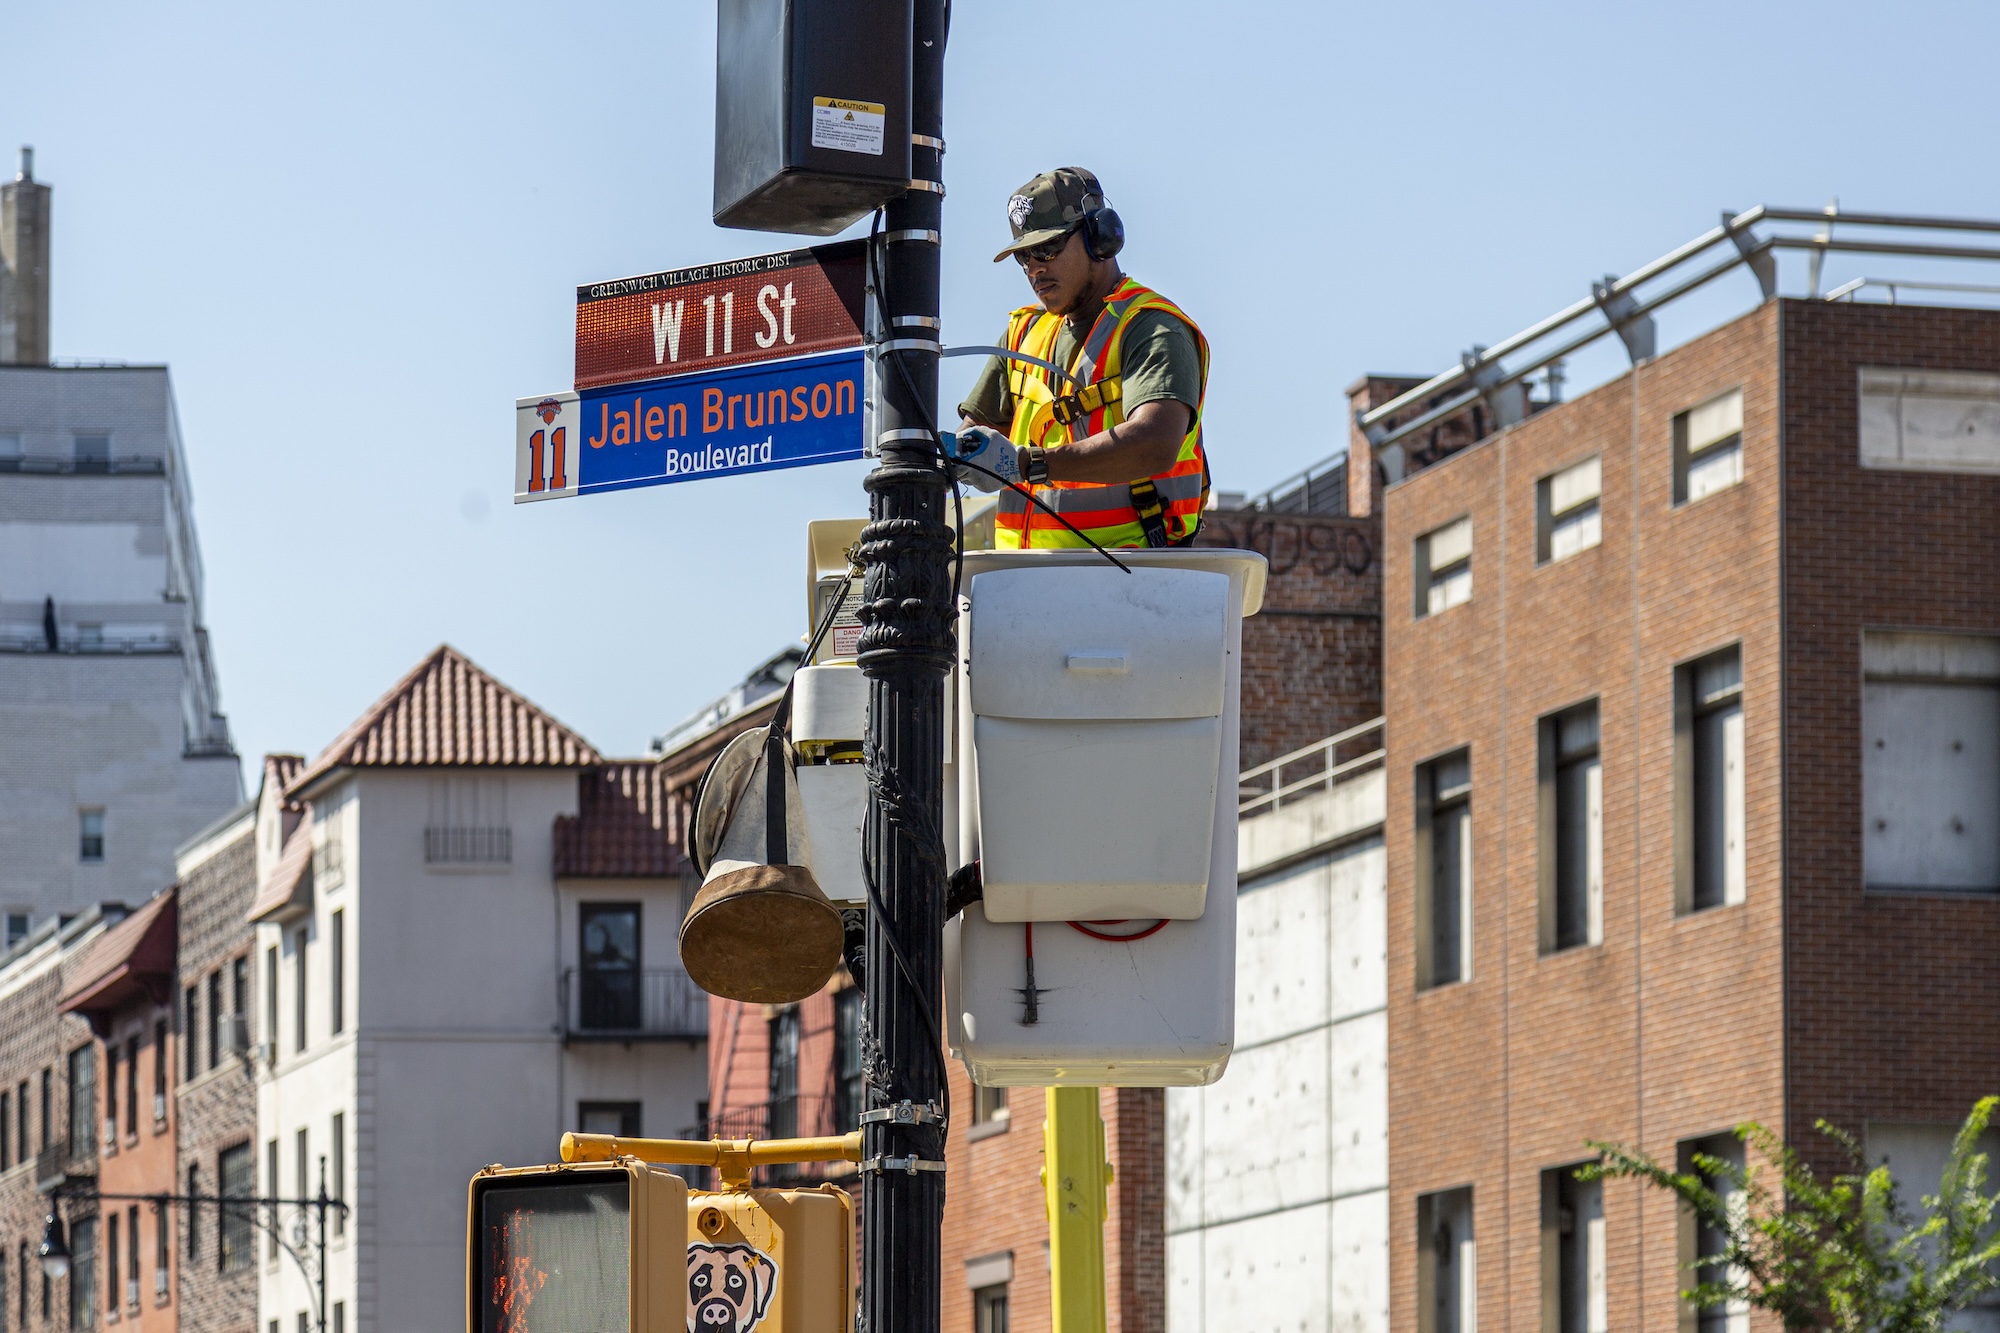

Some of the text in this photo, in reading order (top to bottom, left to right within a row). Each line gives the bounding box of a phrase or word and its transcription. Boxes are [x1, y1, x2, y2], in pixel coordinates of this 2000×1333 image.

[838, 102, 869, 111] CAUTION
[590, 253, 792, 298] GREENWICH VILLAGE HISTORIC DIST
[652, 281, 796, 364] W 11 St
[588, 378, 855, 449] Jalen Brunson
[528, 426, 567, 493] 11
[666, 435, 772, 475] Boulevard
